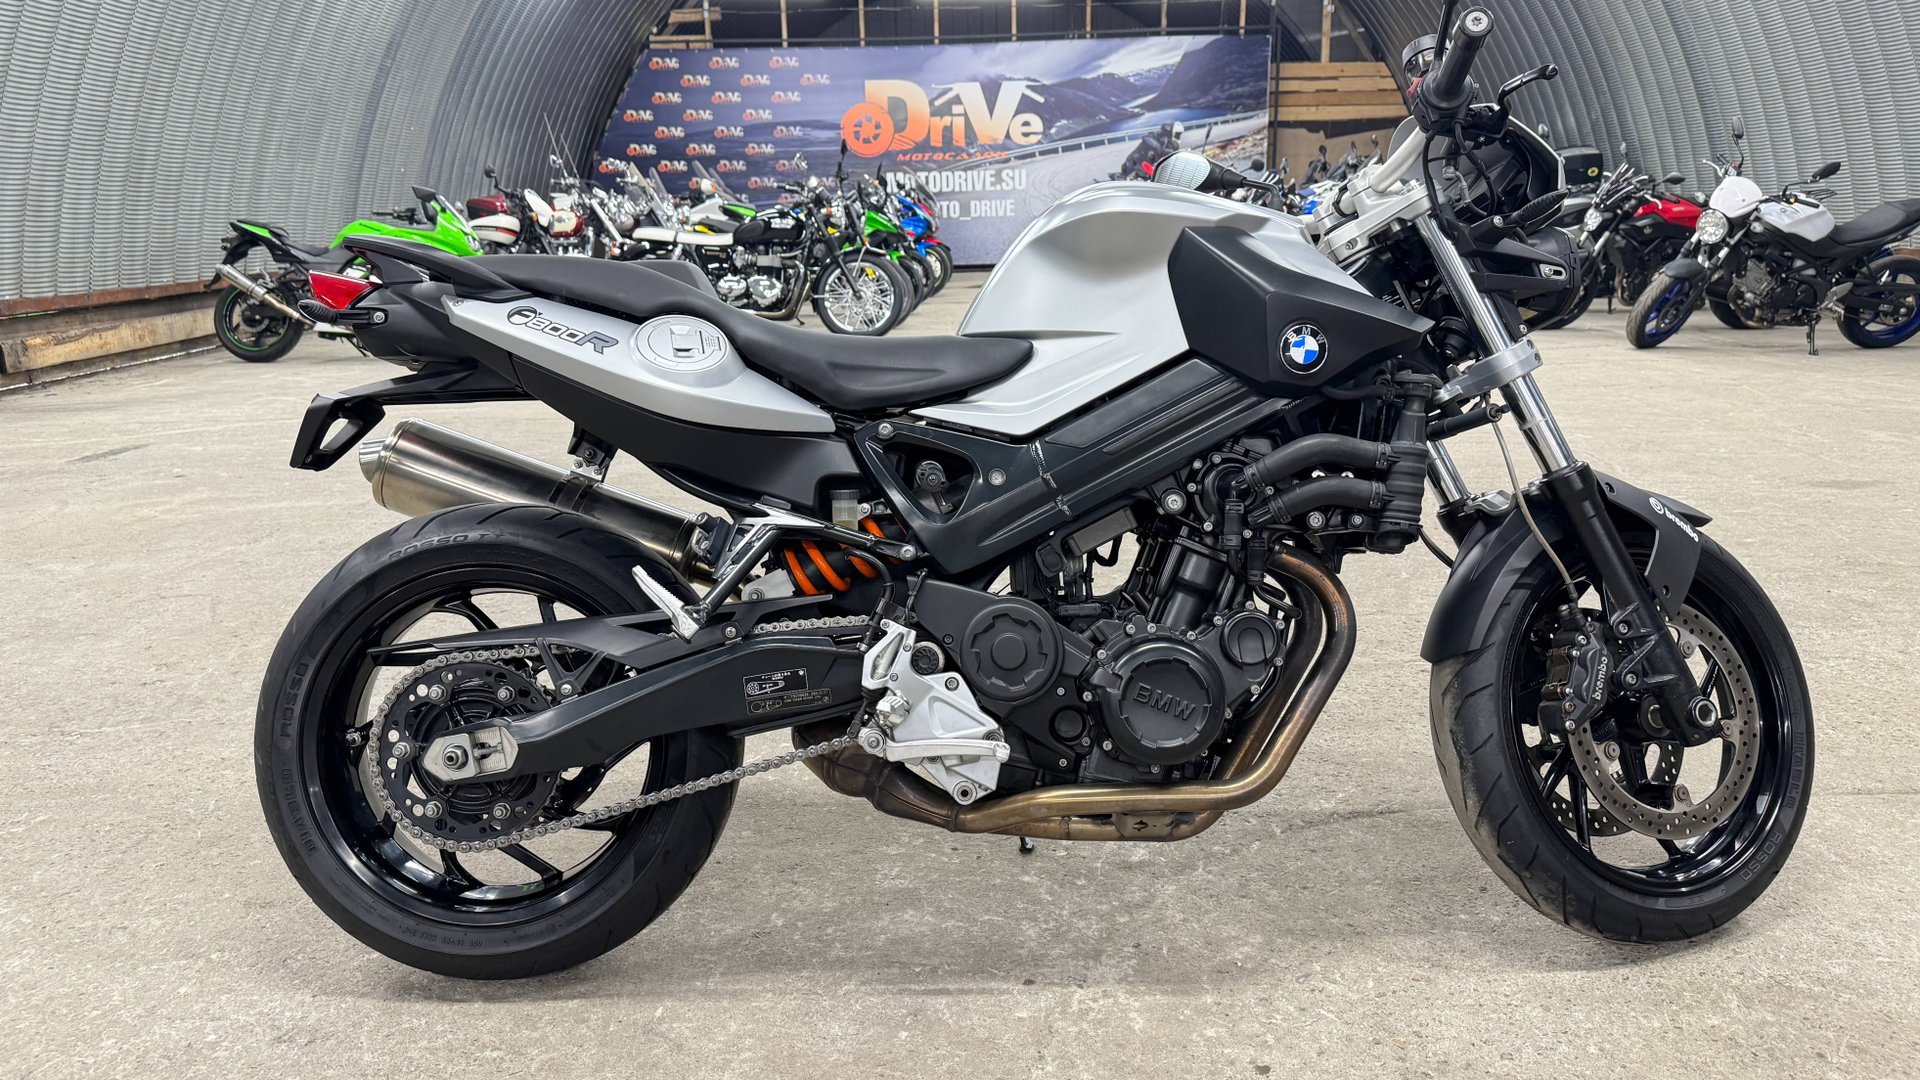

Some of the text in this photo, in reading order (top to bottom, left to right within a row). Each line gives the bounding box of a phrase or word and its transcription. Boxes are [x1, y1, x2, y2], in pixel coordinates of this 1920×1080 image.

[862, 79, 1044, 148] DriVe
[885, 169, 1027, 193] MOTODRIVE.SU
[507, 306, 619, 355] F800R
[1286, 326, 1325, 344] BMW
[1664, 507, 1699, 542] brembo
[1592, 656, 1608, 700] brembo
[1133, 682, 1197, 720] BMW
[1740, 832, 1782, 881] ROSSO
